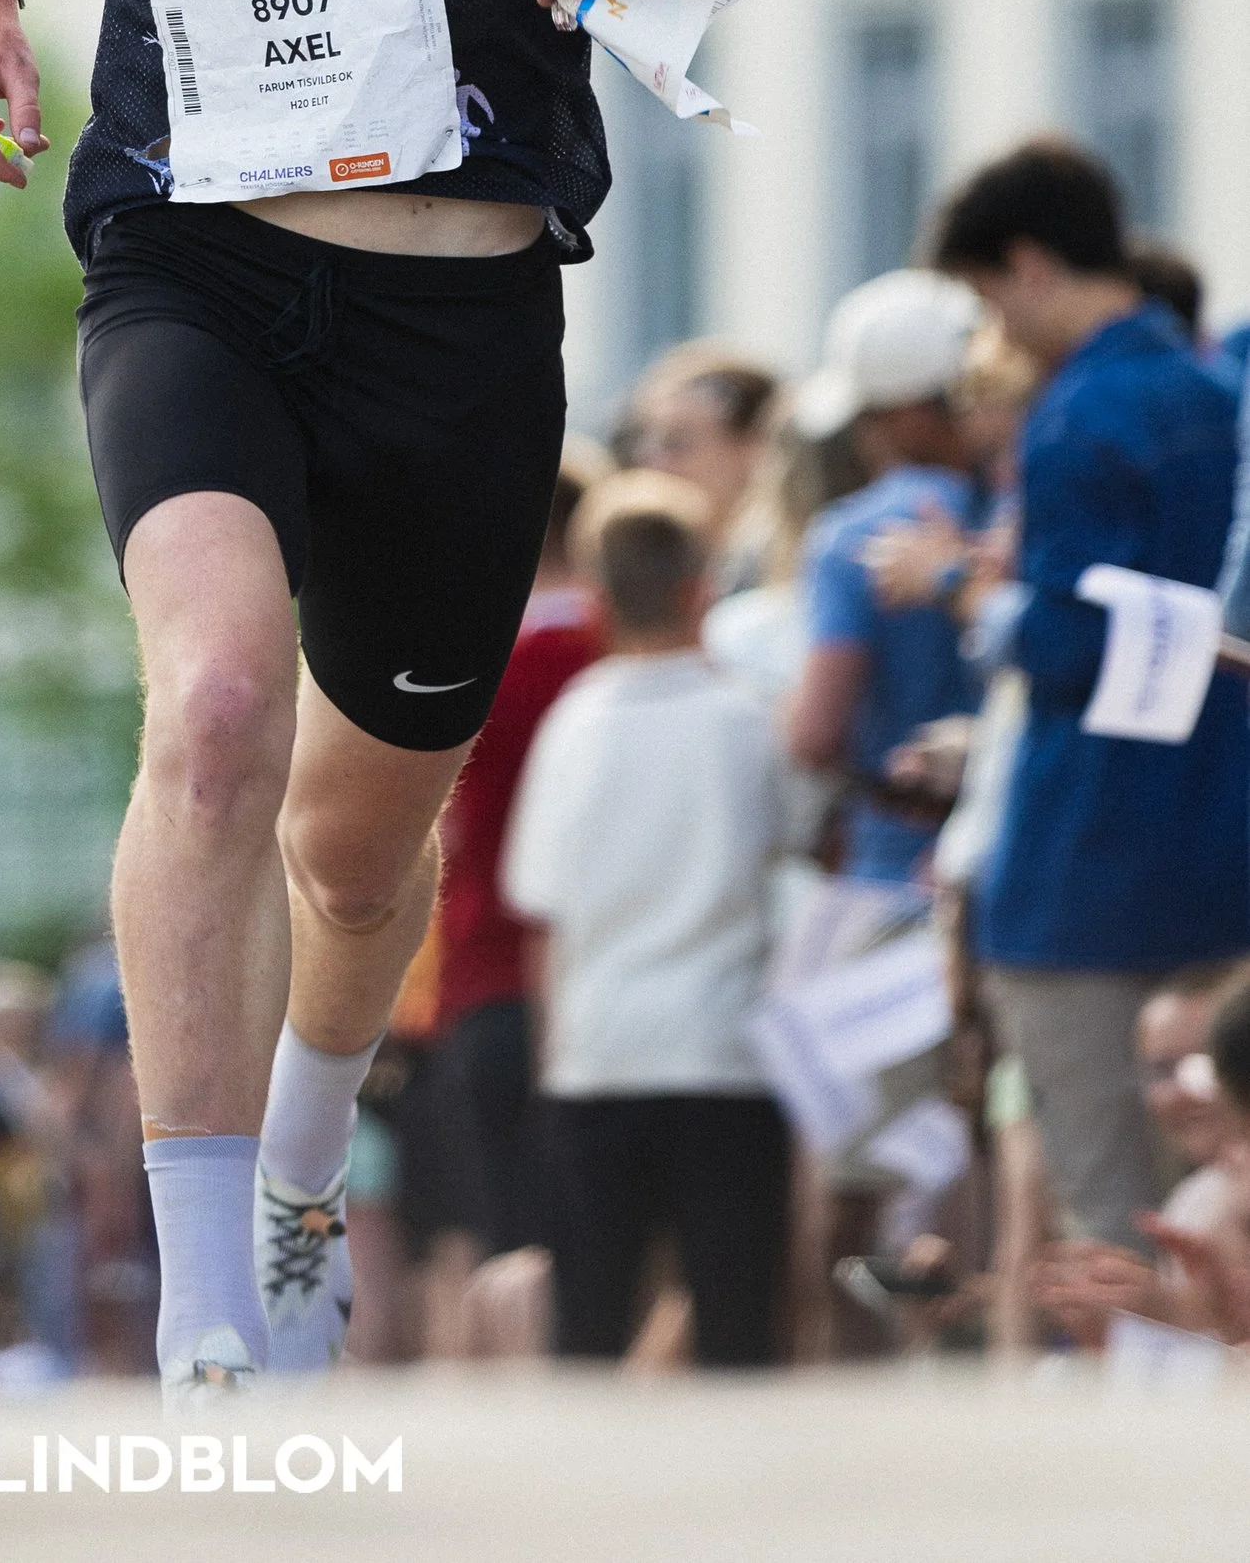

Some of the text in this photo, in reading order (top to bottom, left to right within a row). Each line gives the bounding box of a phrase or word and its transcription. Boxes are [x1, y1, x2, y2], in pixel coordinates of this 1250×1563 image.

[265, 31, 341, 67] AXEL
[259, 71, 353, 93] FARUM TISVILDE OK
[290, 95, 329, 110] H20 ELIT
[239, 165, 313, 183] CHALMERS
